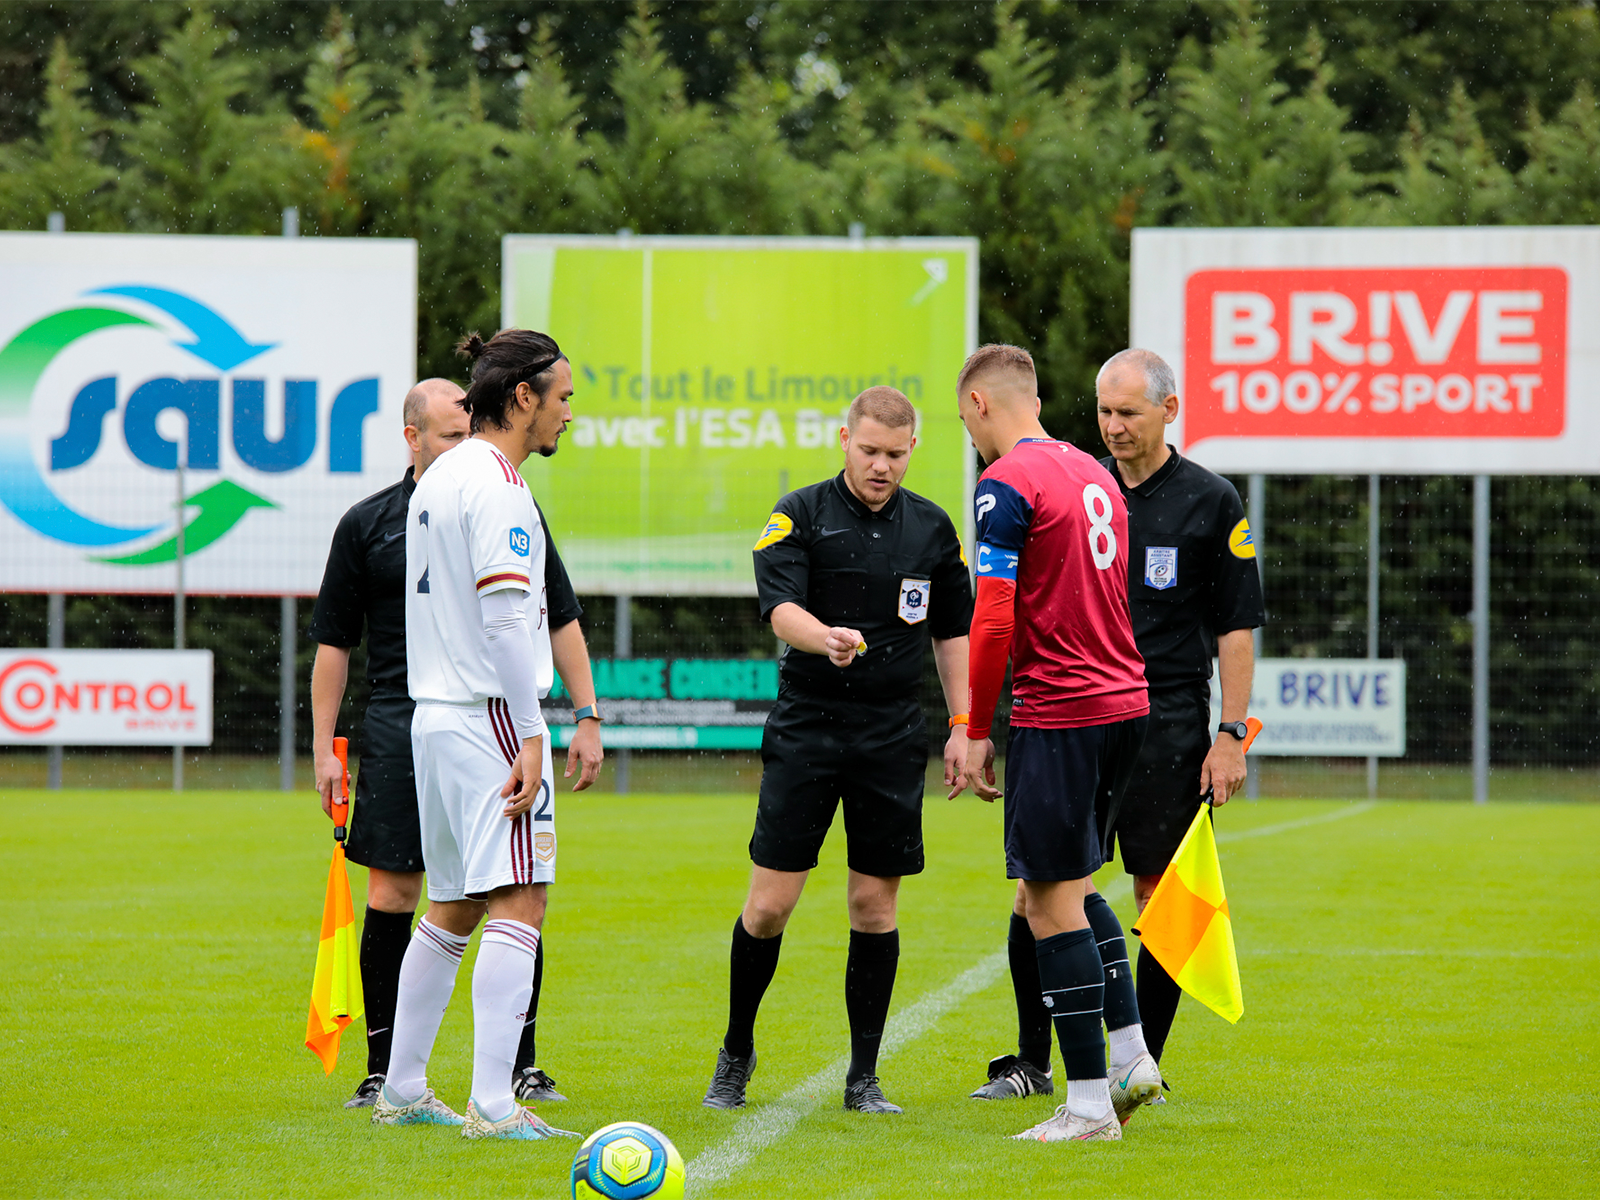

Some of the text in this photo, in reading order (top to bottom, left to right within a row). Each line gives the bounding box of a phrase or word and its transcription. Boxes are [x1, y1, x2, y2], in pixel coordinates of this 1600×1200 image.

[604, 366, 691, 402] Tout
[703, 363, 736, 402] le
[1211, 370, 1542, 414] 100% SPORT
[50, 374, 381, 474] saur
[572, 415, 665, 448] avec
[674, 406, 786, 448] l'ESA
[511, 531, 528, 550] N3
[1083, 483, 1117, 570] 8
[977, 545, 993, 573] C
[0, 658, 196, 733] CONTROL
[1280, 672, 1389, 707] BRIVE
[534, 779, 552, 821] 2
